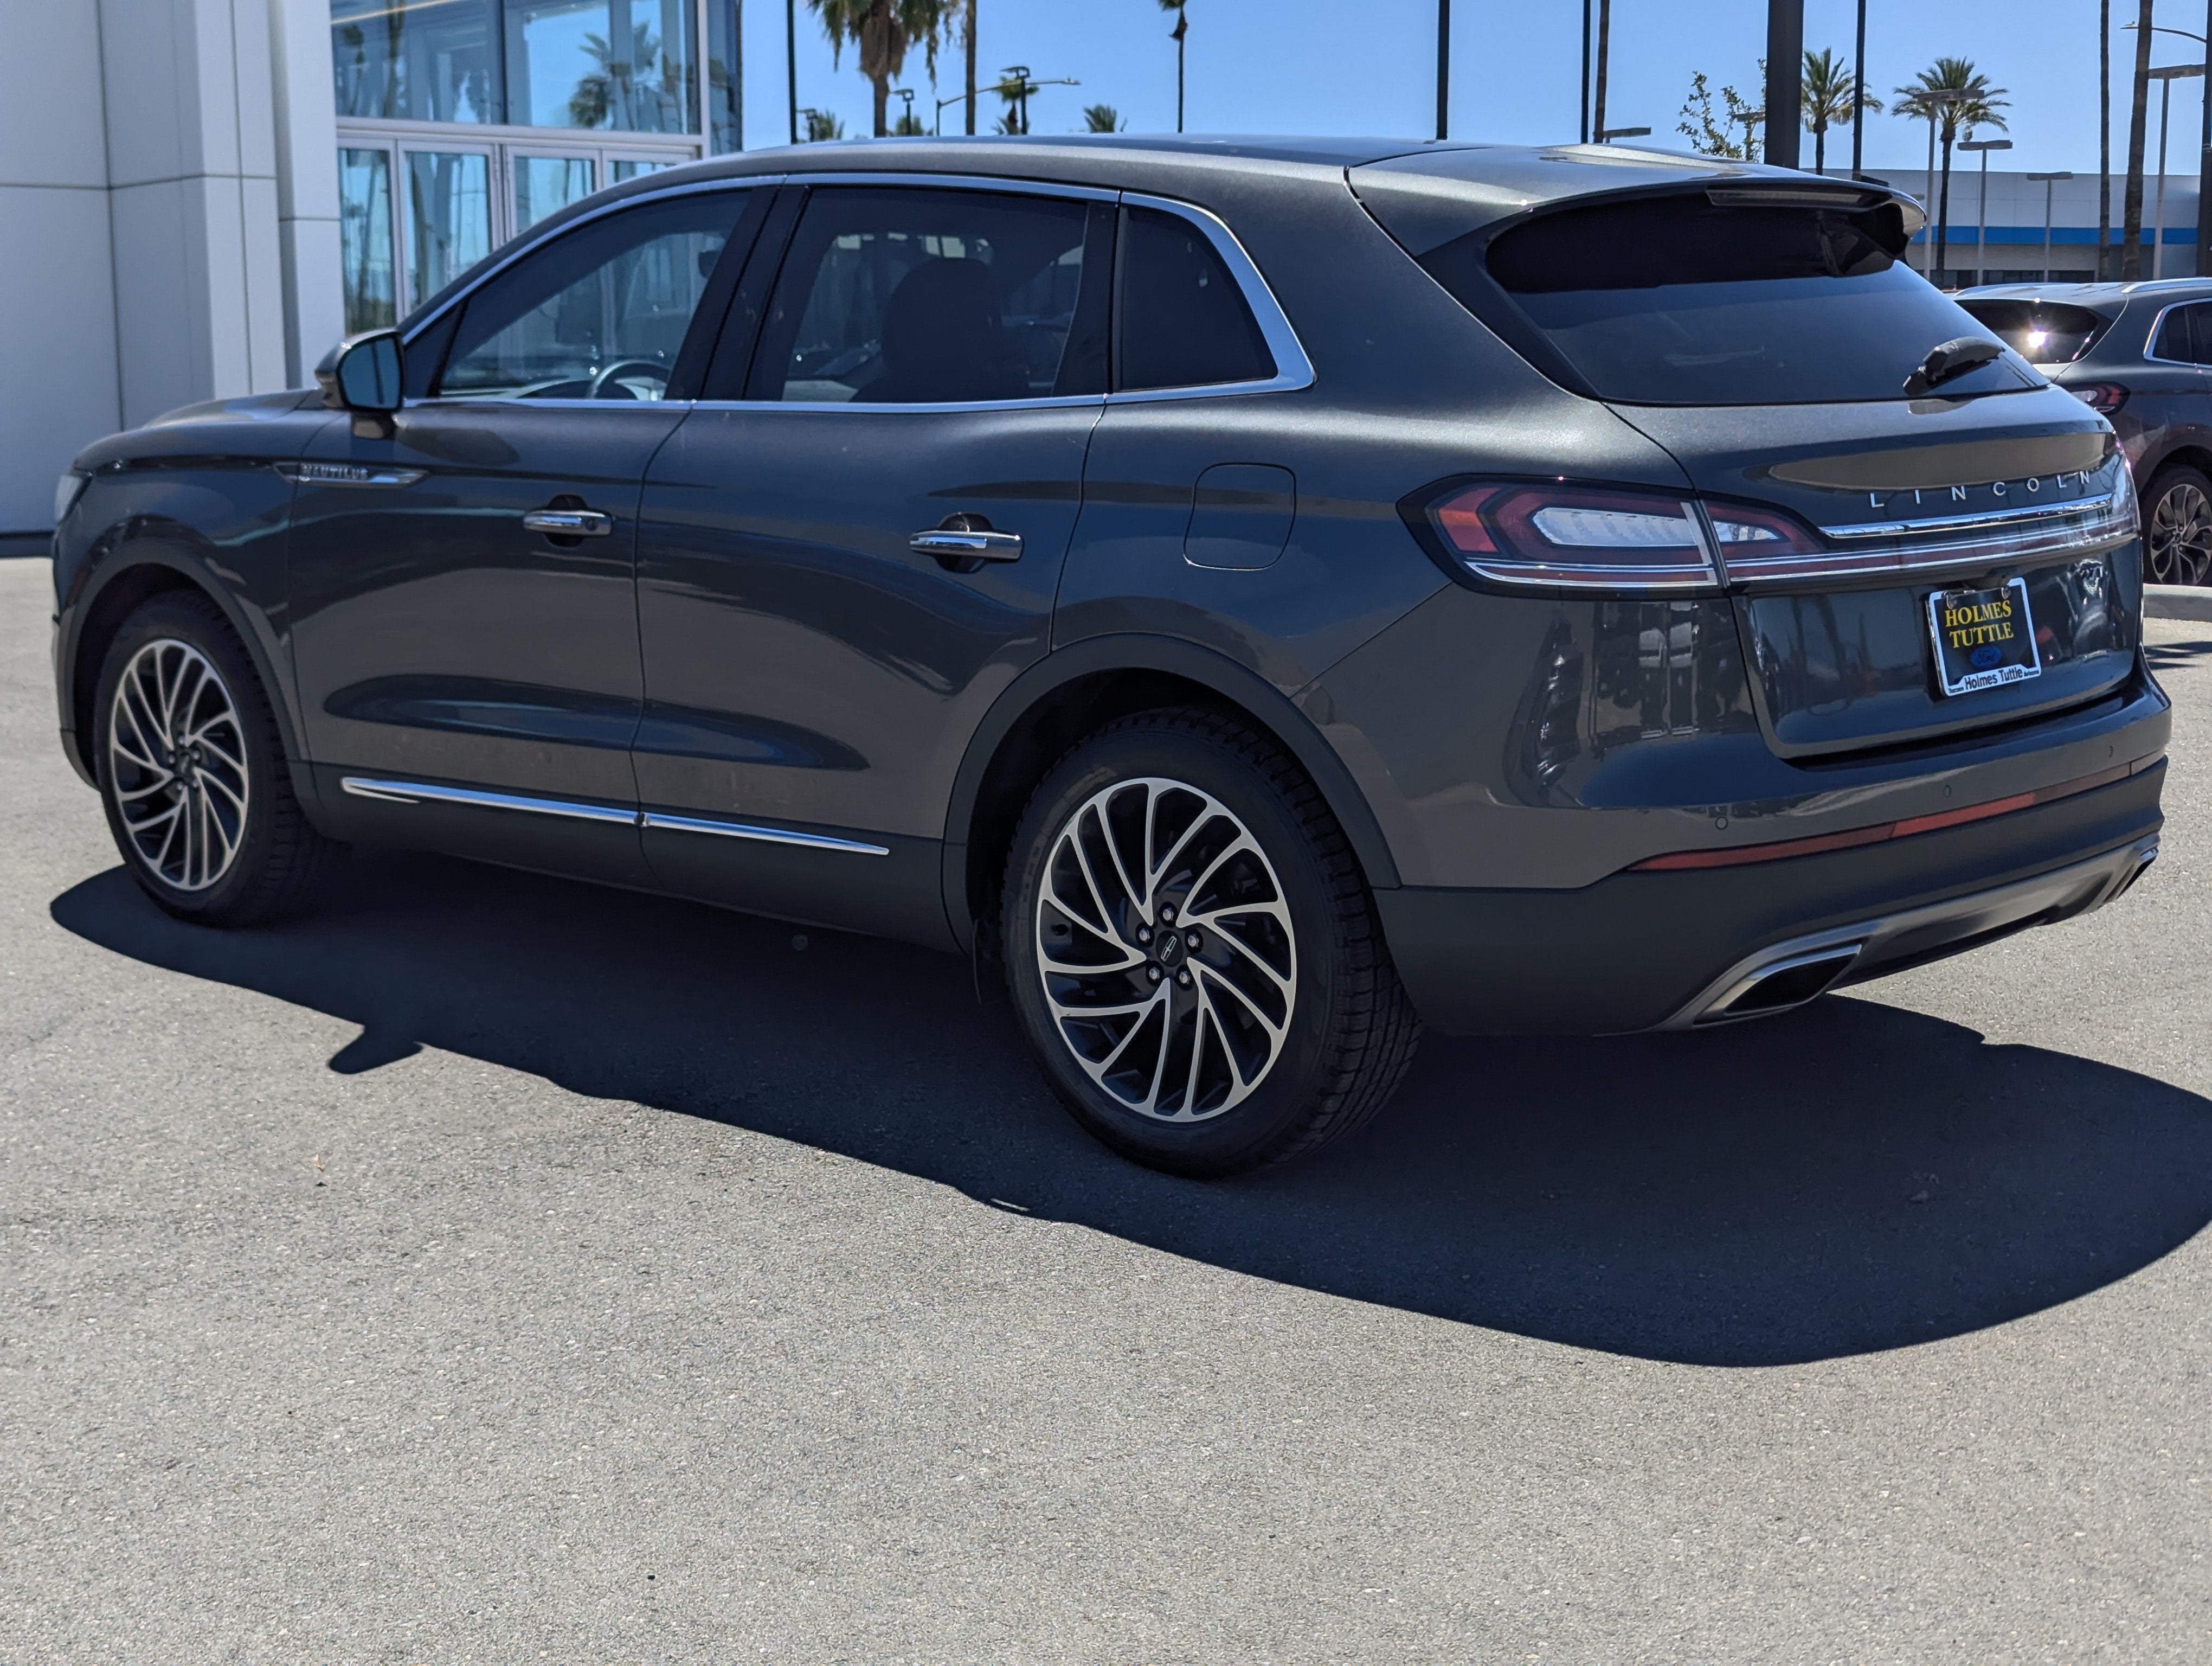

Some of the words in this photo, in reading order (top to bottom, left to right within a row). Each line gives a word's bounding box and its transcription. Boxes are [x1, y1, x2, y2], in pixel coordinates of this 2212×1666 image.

[1869, 470, 2090, 509] LINCOLN
[1945, 600, 2012, 627] HOLMES
[1949, 622, 2014, 648] TUTTLE
[1964, 674, 1998, 690] Holmes
[1998, 667, 2023, 682] Tuttle
